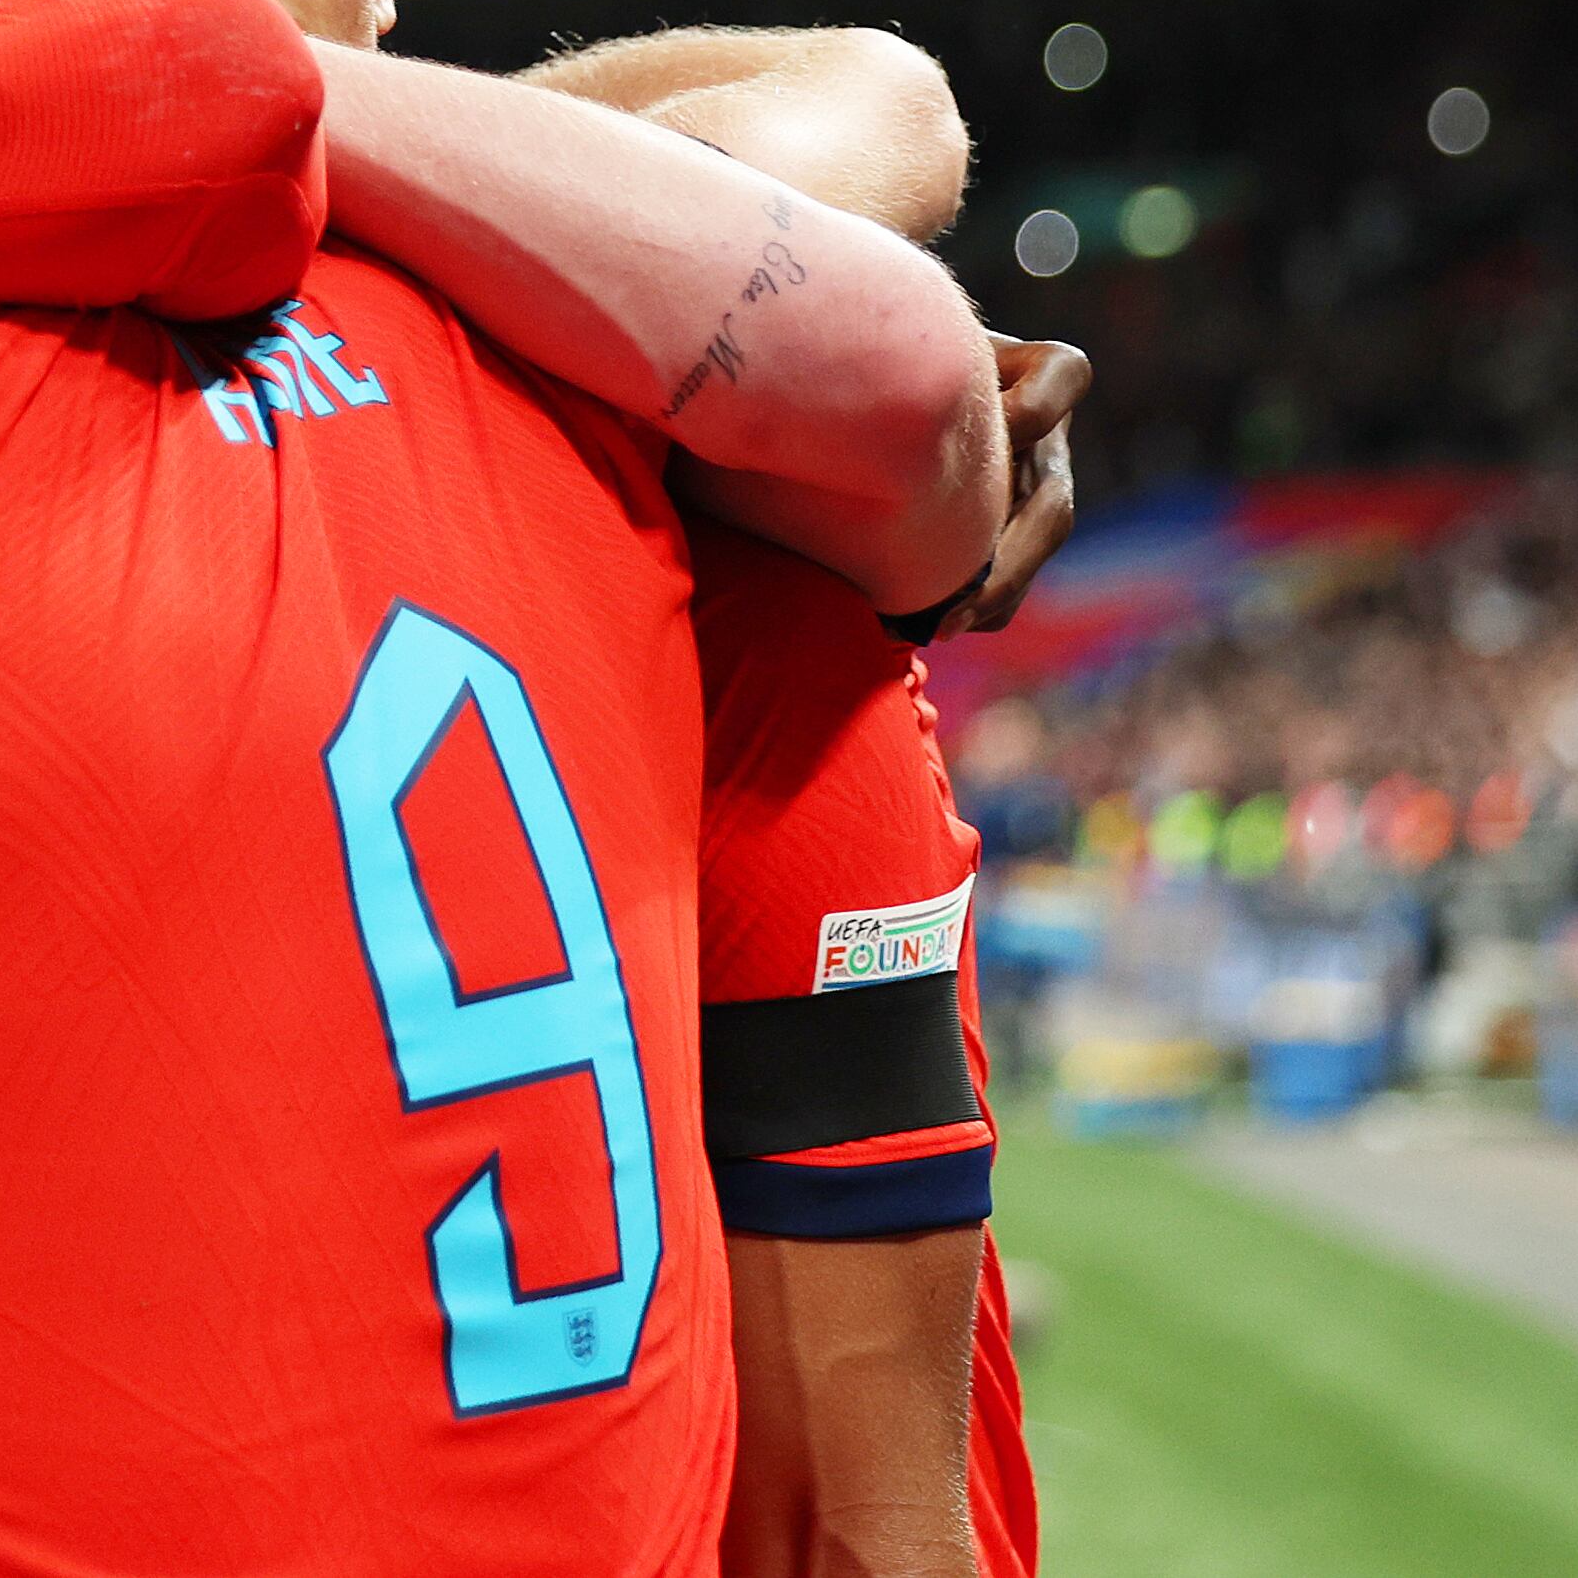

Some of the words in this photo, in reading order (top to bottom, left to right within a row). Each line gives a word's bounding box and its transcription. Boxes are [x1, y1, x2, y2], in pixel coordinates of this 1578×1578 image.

[742, 241, 806, 302] Else
[172, 299, 391, 448] KNE
[827, 918, 882, 941] UEFA
[322, 596, 662, 1419] 9
